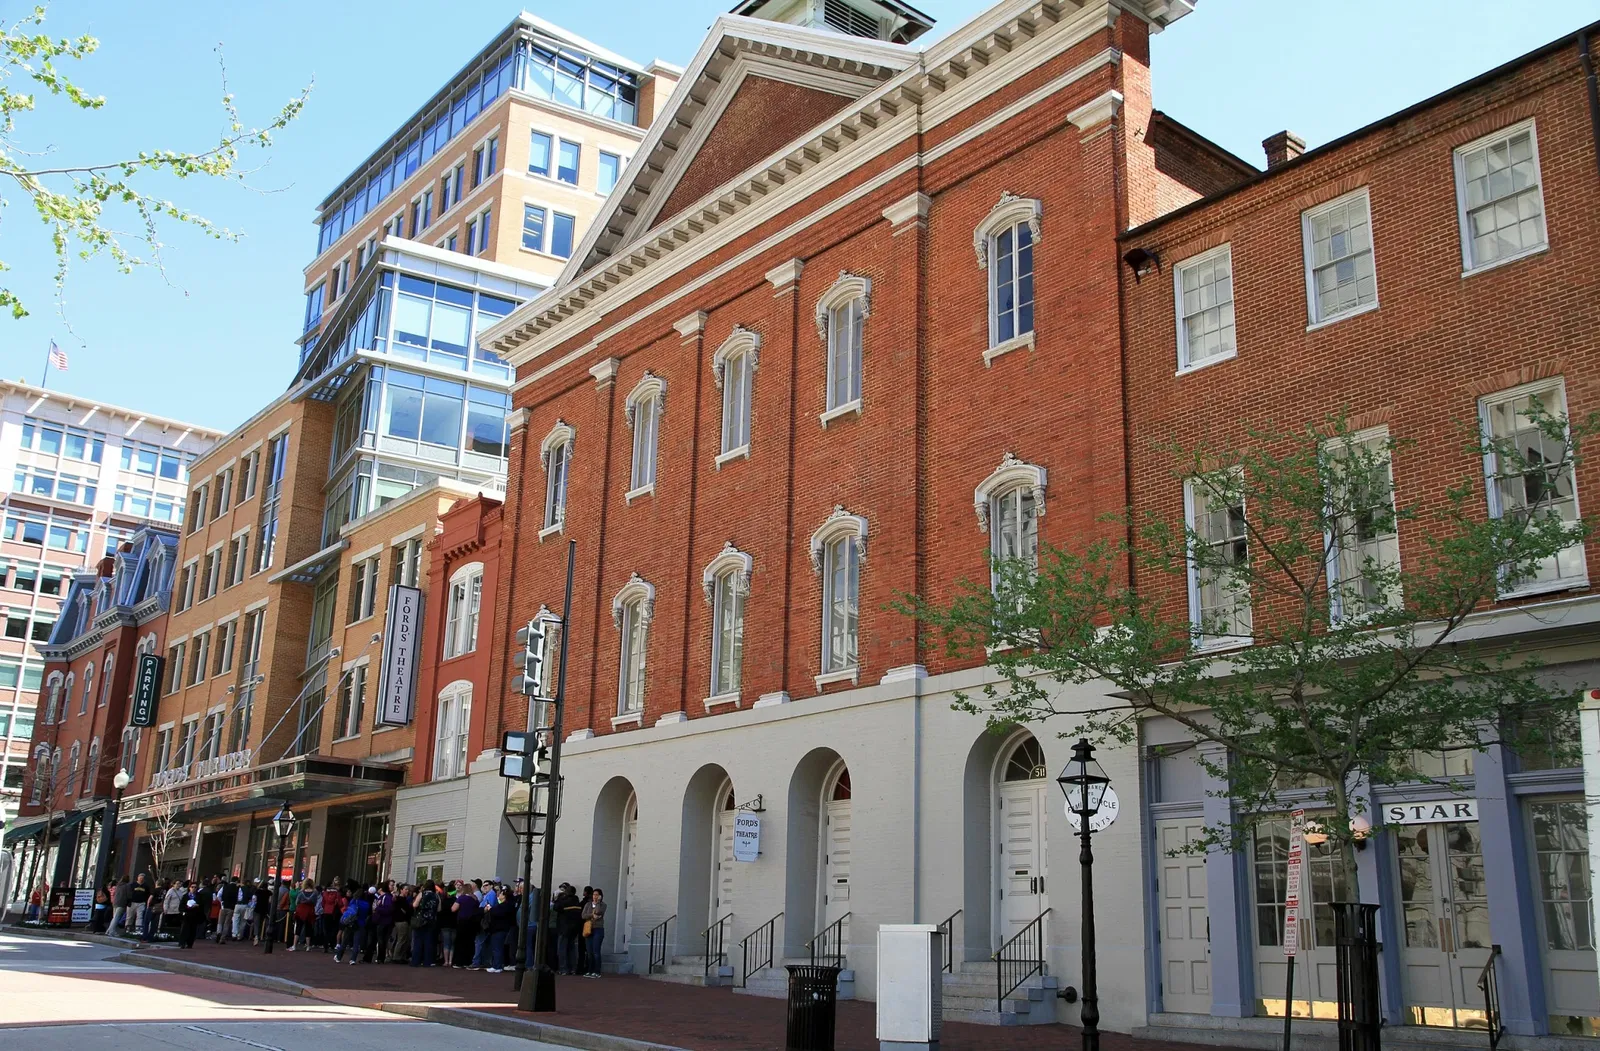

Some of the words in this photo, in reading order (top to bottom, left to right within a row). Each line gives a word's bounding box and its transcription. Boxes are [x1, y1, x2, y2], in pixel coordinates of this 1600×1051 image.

[139, 660, 154, 715] PARKING
[393, 647, 407, 714] THEATRE
[1035, 768, 1046, 777] 511
[1390, 803, 1473, 820] STAR
[1090, 815, 1111, 830] ENTS
[736, 831, 757, 839] THEATRE
